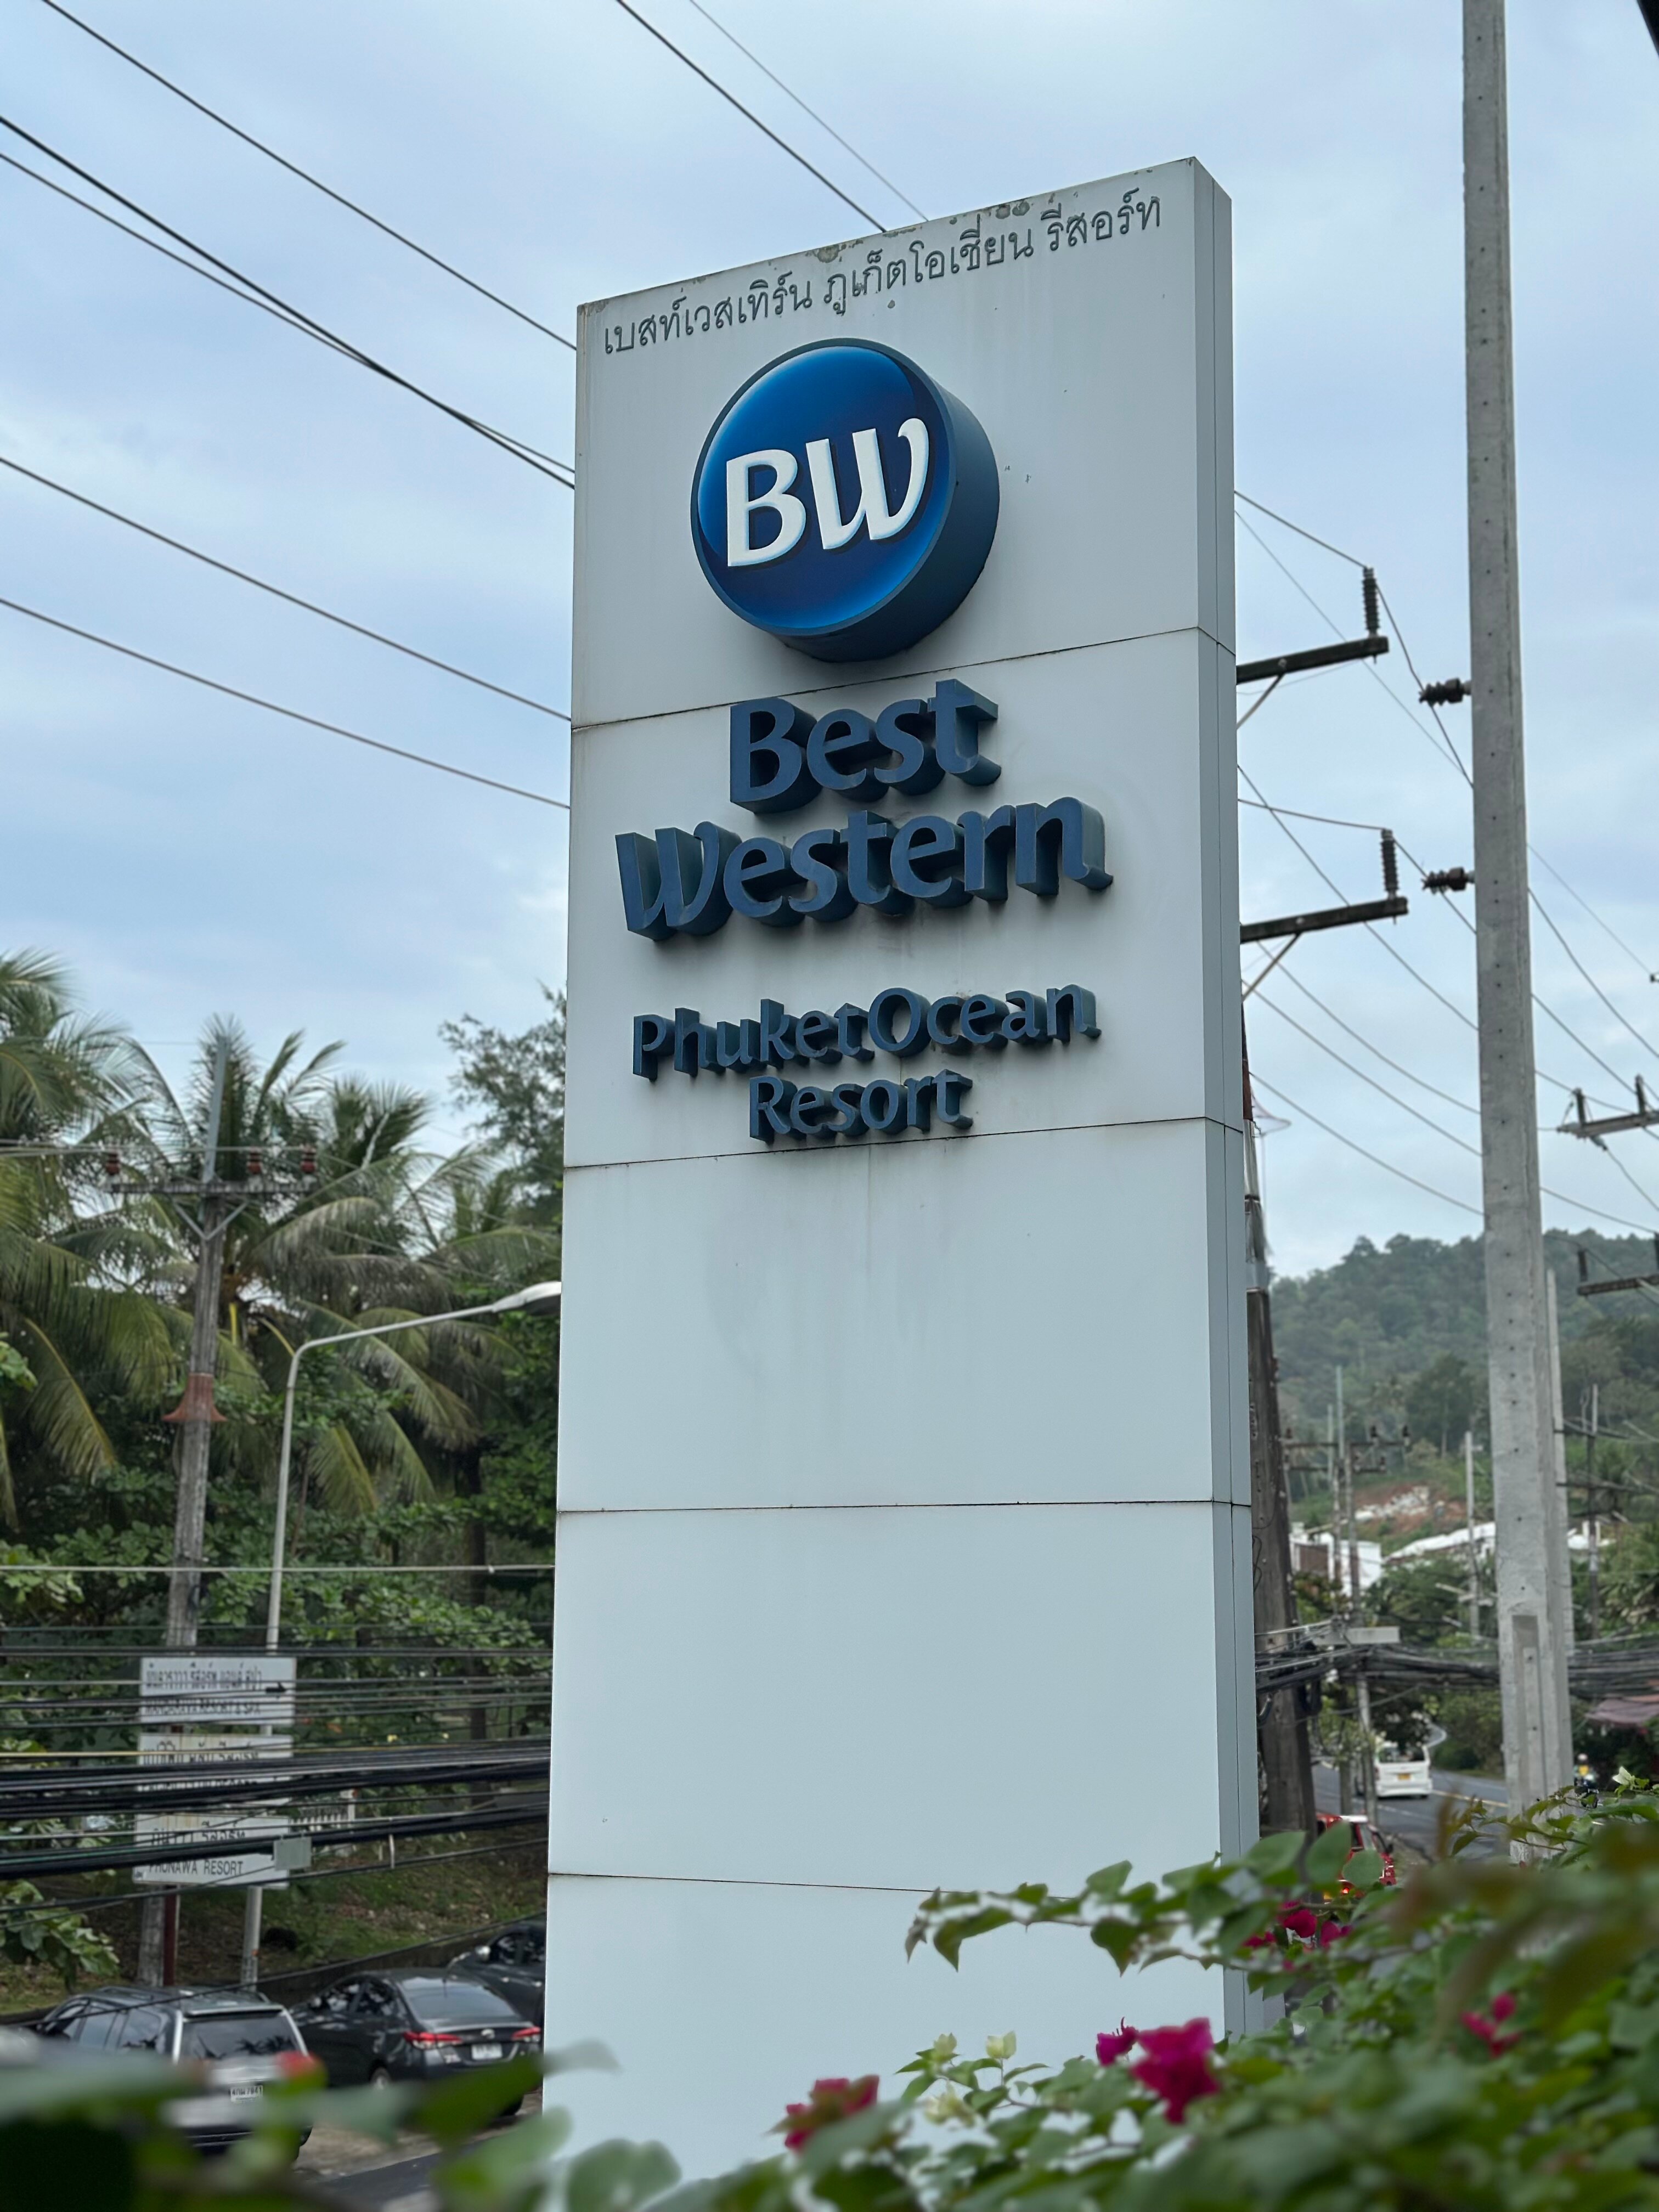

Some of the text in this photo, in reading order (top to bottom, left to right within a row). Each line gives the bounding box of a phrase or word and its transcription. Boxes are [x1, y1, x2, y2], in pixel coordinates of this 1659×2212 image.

[605, 270, 813, 354] เบสท์เวสเทิร์น
[1040, 188, 1161, 251] รีสอร์ท
[726, 417, 929, 567] BW
[730, 679, 1002, 813] Best
[614, 797, 1114, 941] Western
[749, 1069, 973, 1143] Resort
[204, 1859, 243, 1876] RESORT
